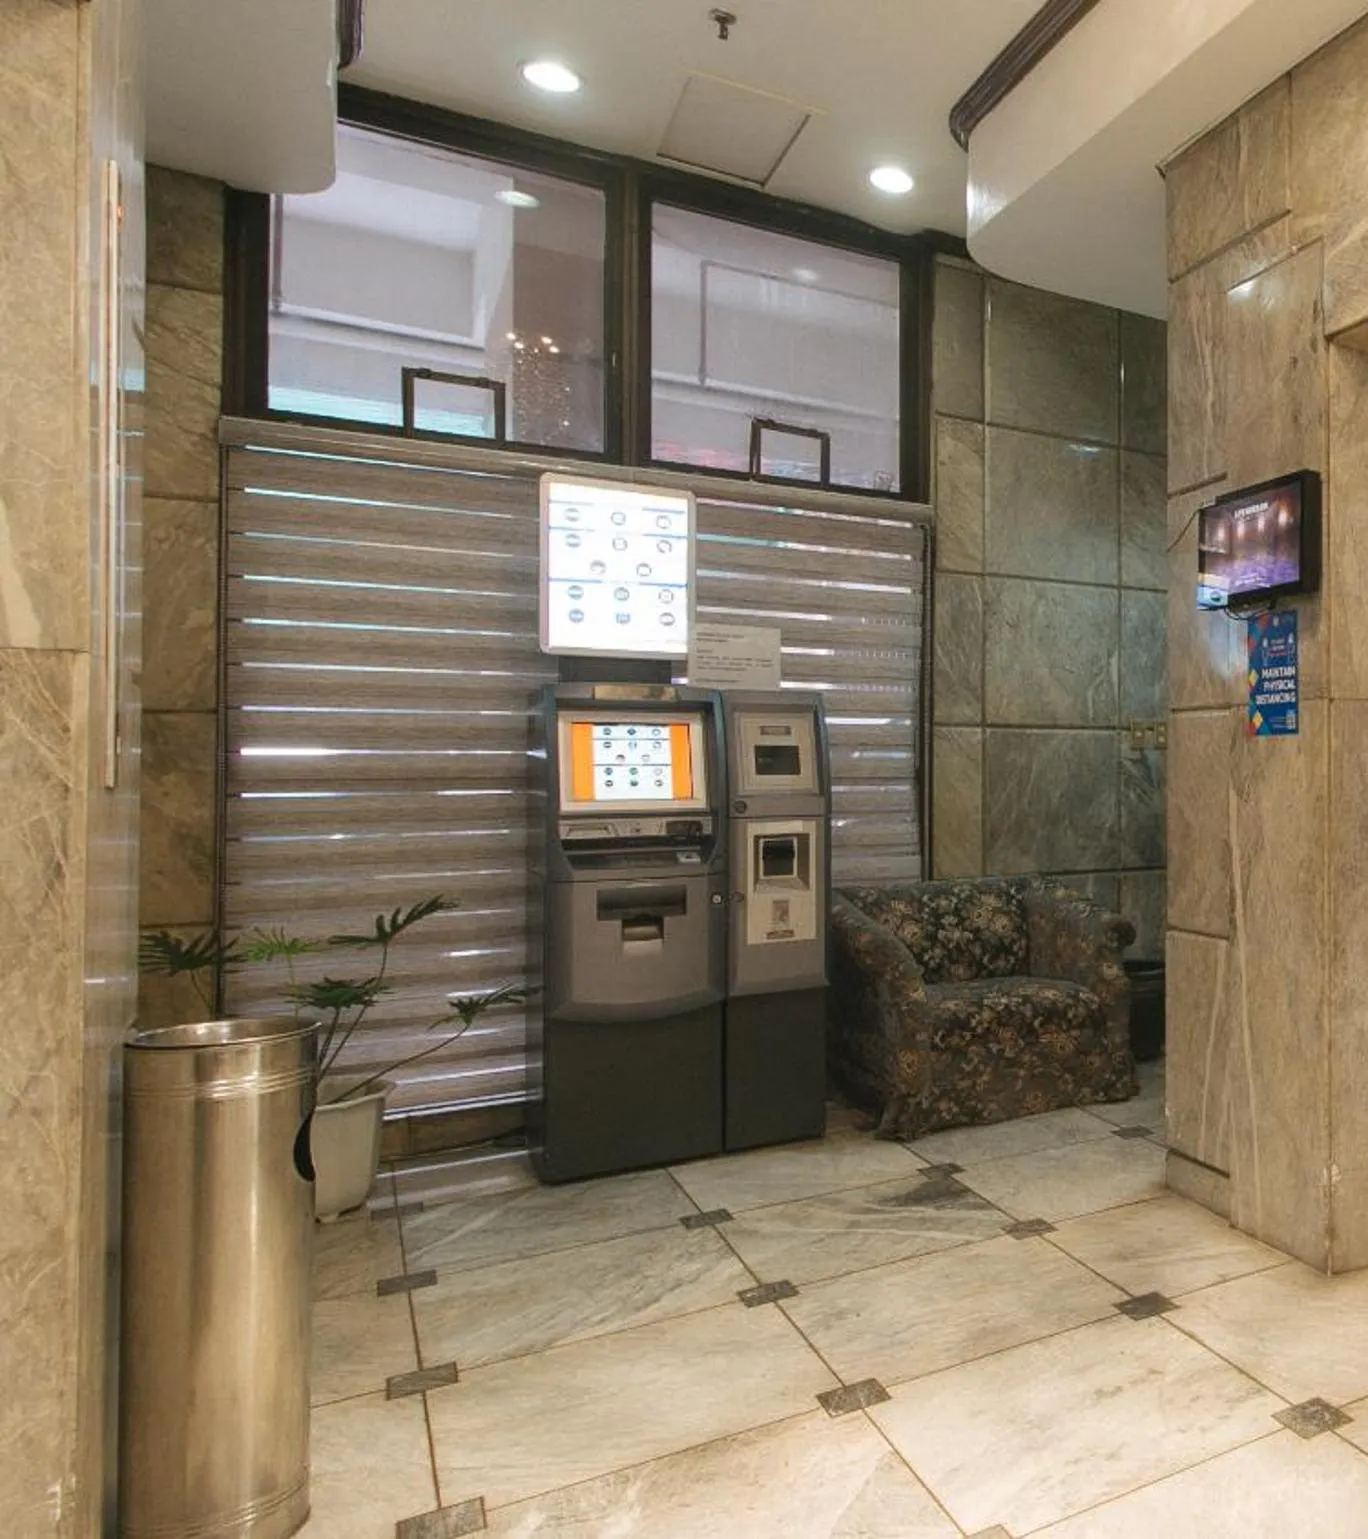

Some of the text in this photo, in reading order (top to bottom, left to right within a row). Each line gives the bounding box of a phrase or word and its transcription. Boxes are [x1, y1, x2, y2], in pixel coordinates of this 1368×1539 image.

[1261, 666, 1296, 679] MAINTAIN
[1263, 679, 1296, 692] PHYSICAL
[1255, 691, 1296, 705] DISTANCING
